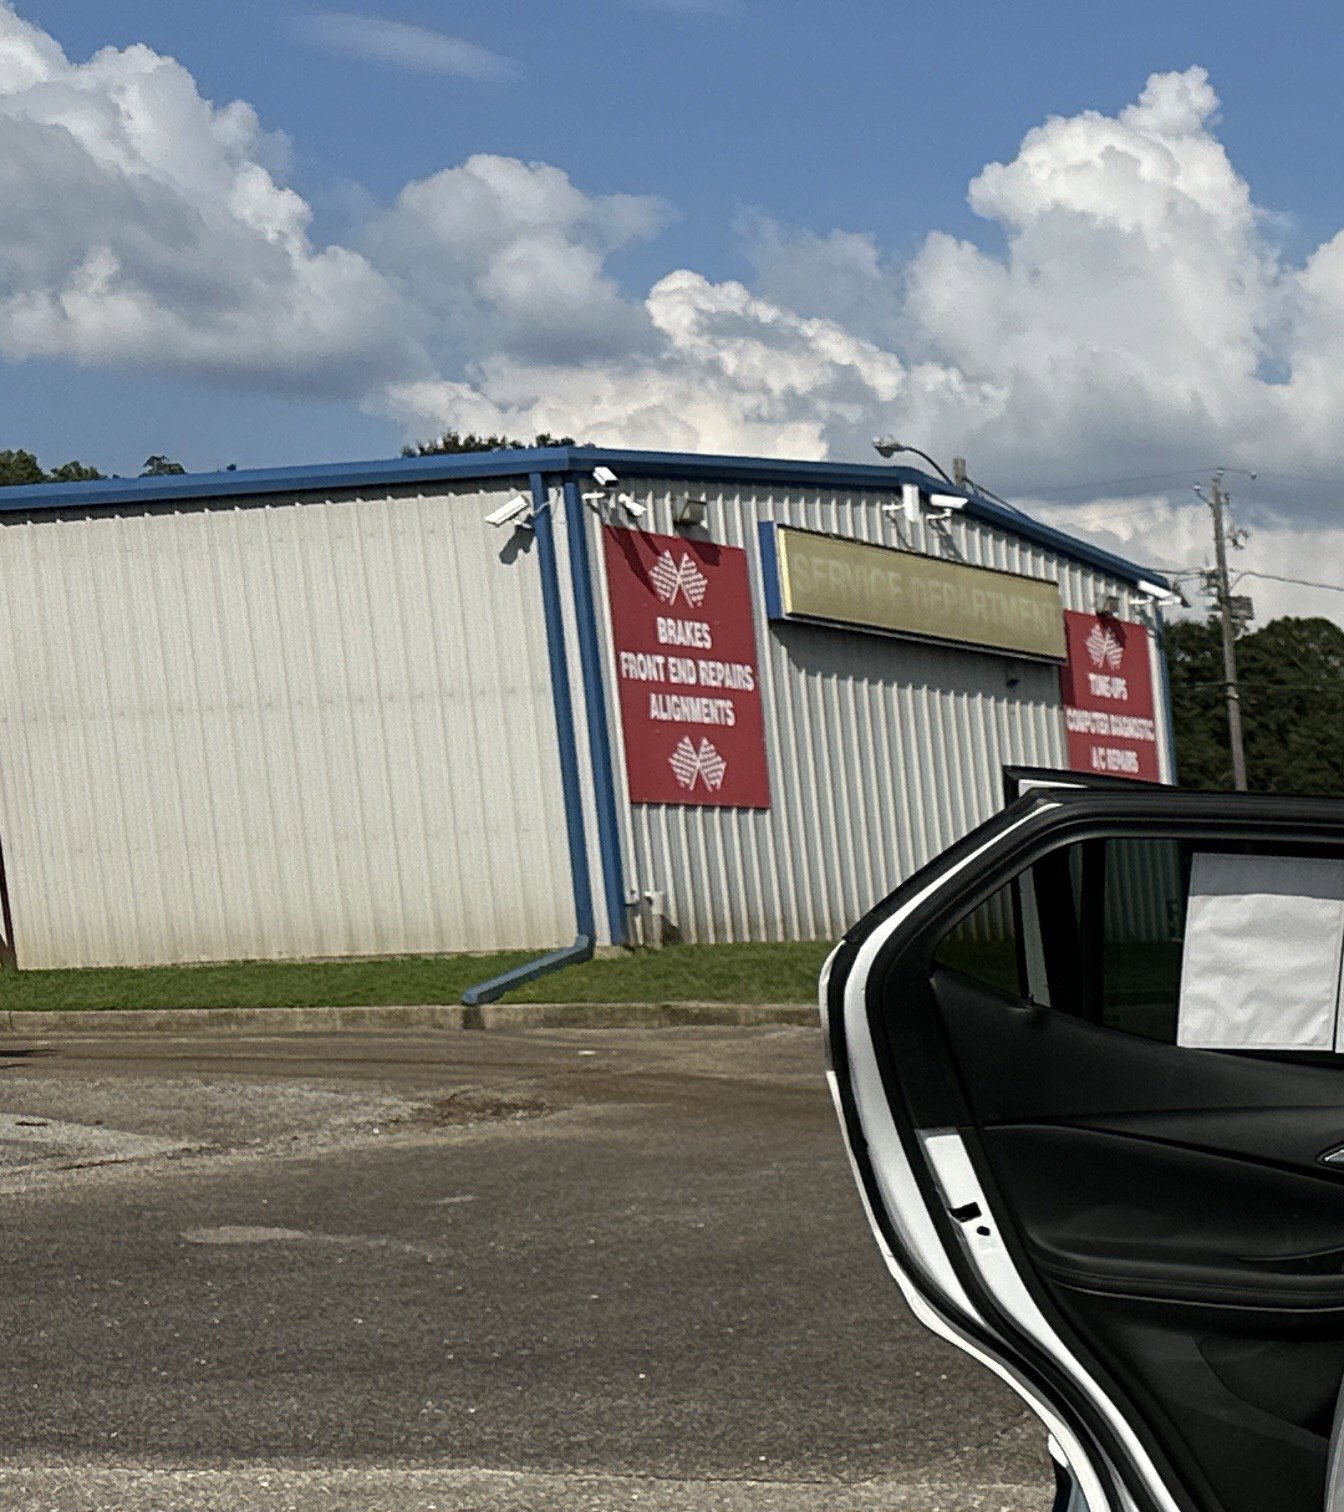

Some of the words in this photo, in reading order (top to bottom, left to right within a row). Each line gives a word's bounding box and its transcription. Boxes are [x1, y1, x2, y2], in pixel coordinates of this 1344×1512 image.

[656, 616, 713, 650] BRAKES
[619, 651, 666, 683] FRONT
[667, 656, 697, 684] END
[698, 659, 755, 692] REPAIRS
[650, 692, 736, 727] ALIGNMENTS
